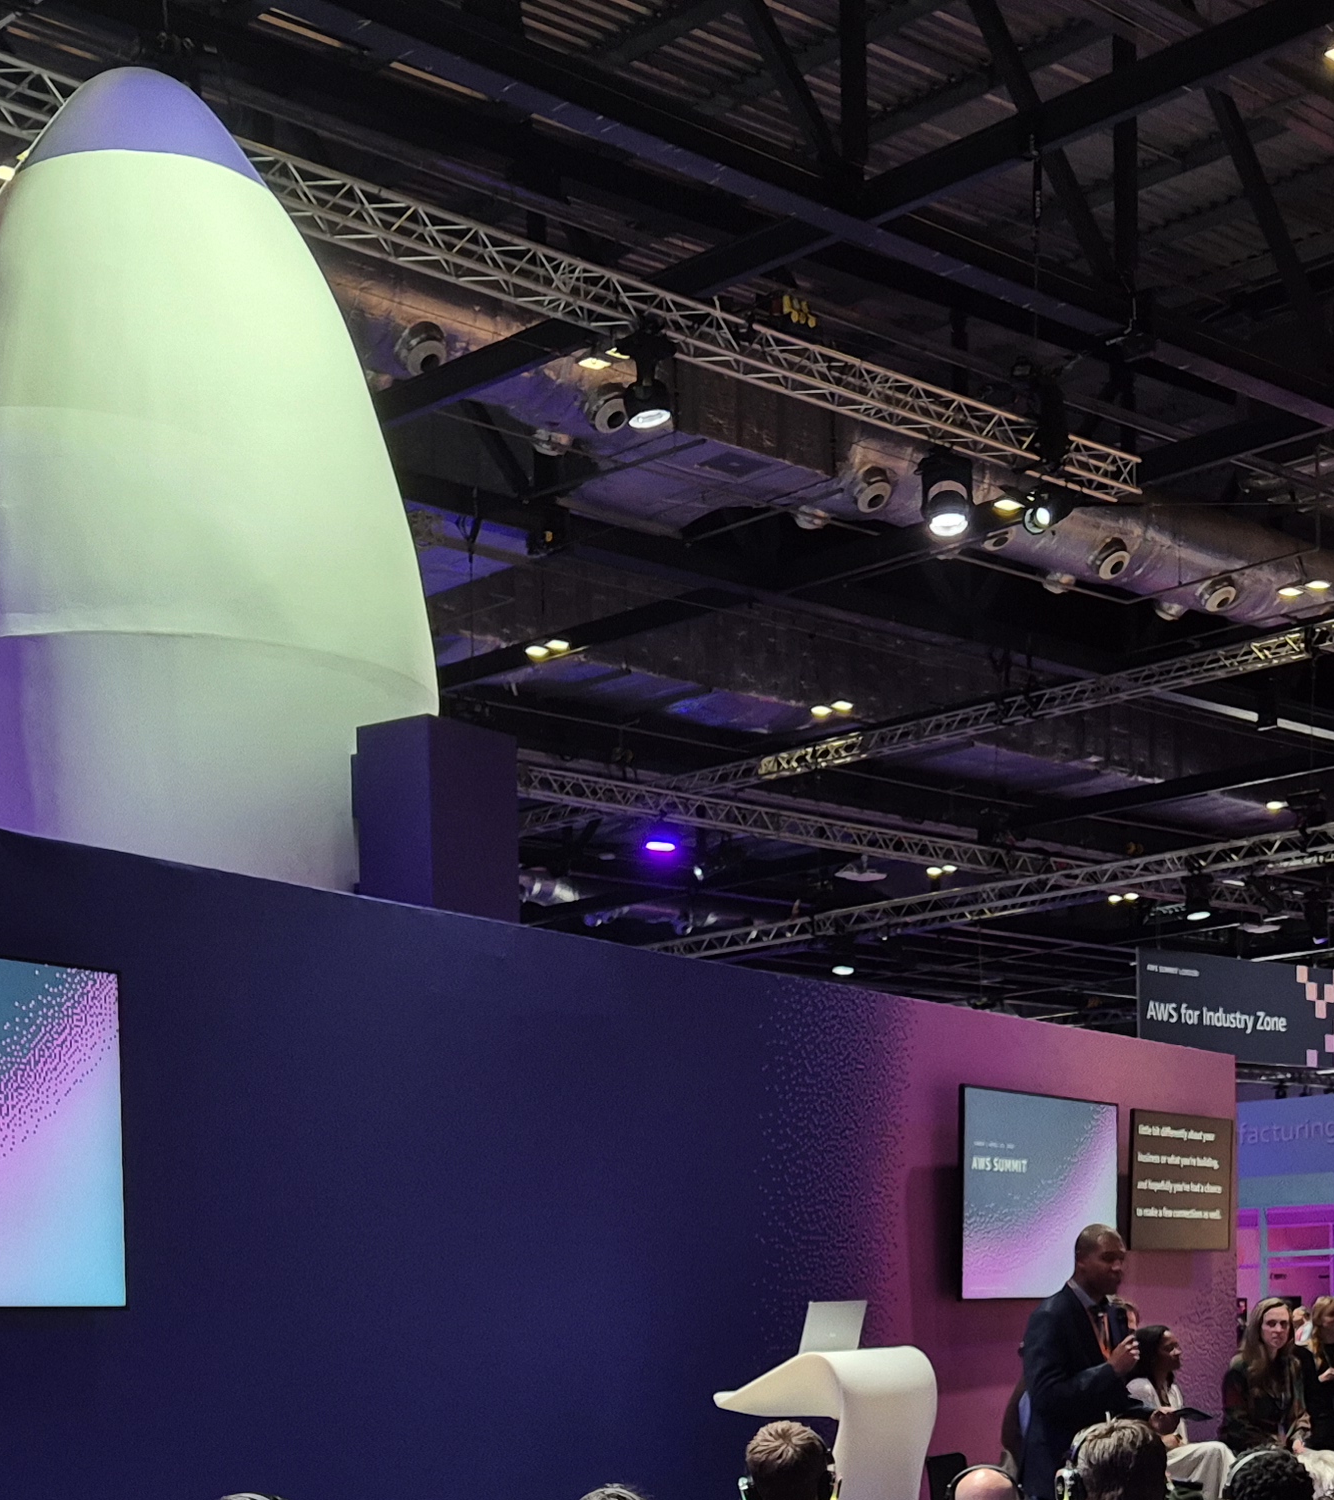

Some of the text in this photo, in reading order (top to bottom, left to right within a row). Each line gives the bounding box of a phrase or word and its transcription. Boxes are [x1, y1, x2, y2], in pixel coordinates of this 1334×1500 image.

[1146, 999, 1288, 1035] AWS for Industry Zone
[971, 1156, 1028, 1173] AWS SUMMIT
